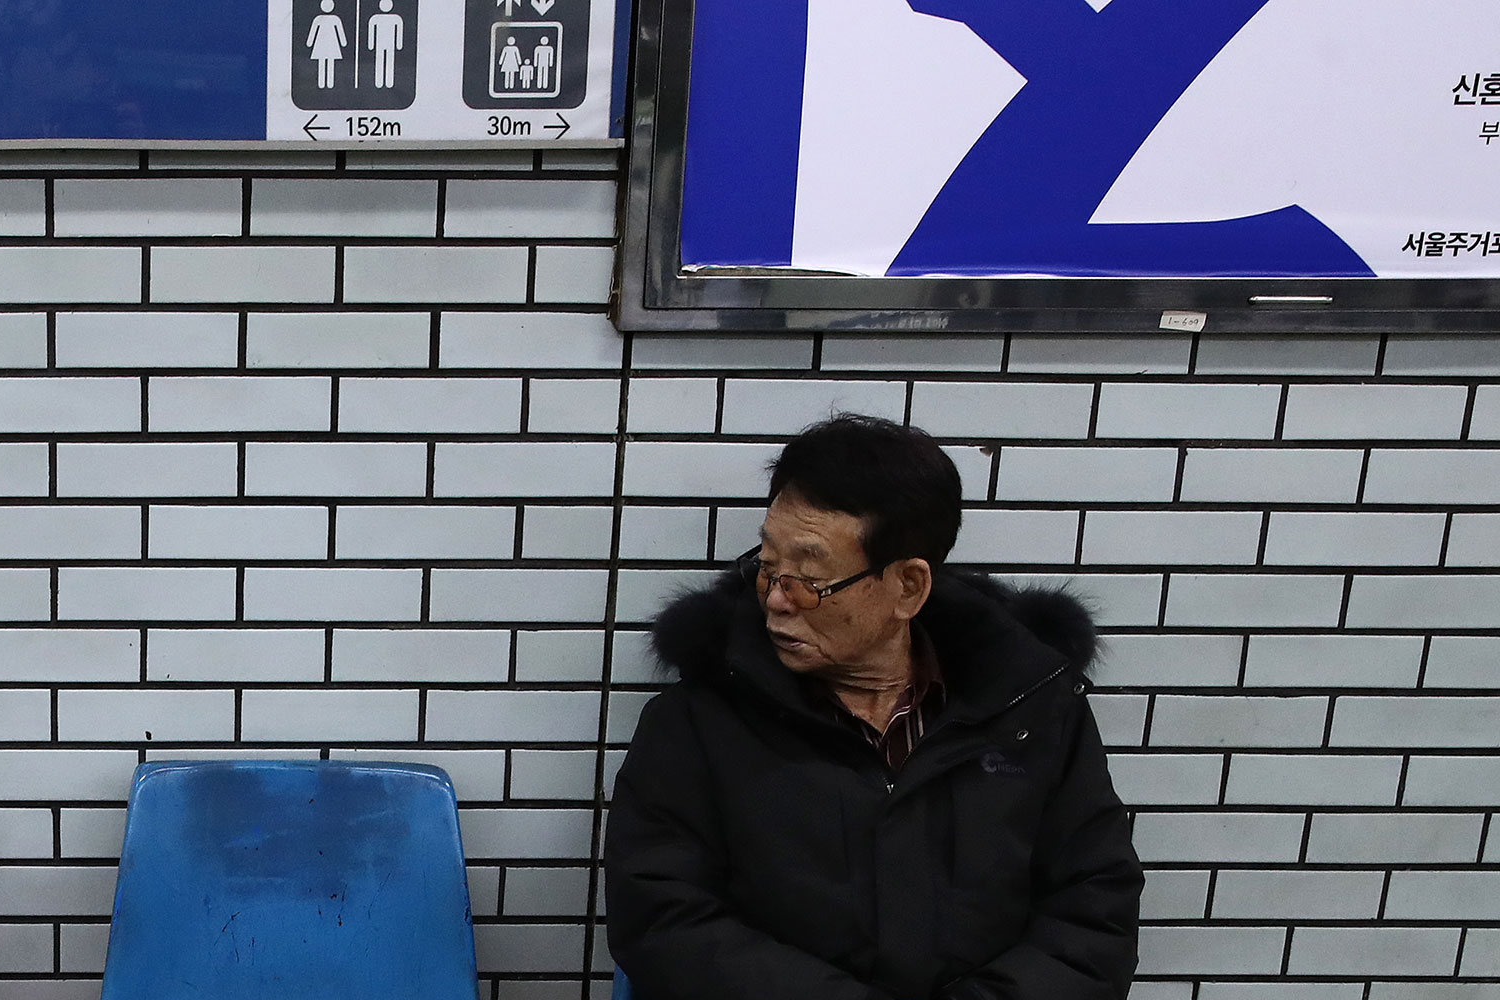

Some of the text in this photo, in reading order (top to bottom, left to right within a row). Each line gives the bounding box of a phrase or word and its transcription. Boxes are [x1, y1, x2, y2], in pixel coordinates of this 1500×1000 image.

[345, 116, 401, 137] 152m
[487, 116, 531, 136] 30m
[1479, 121, 1500, 145] 부
